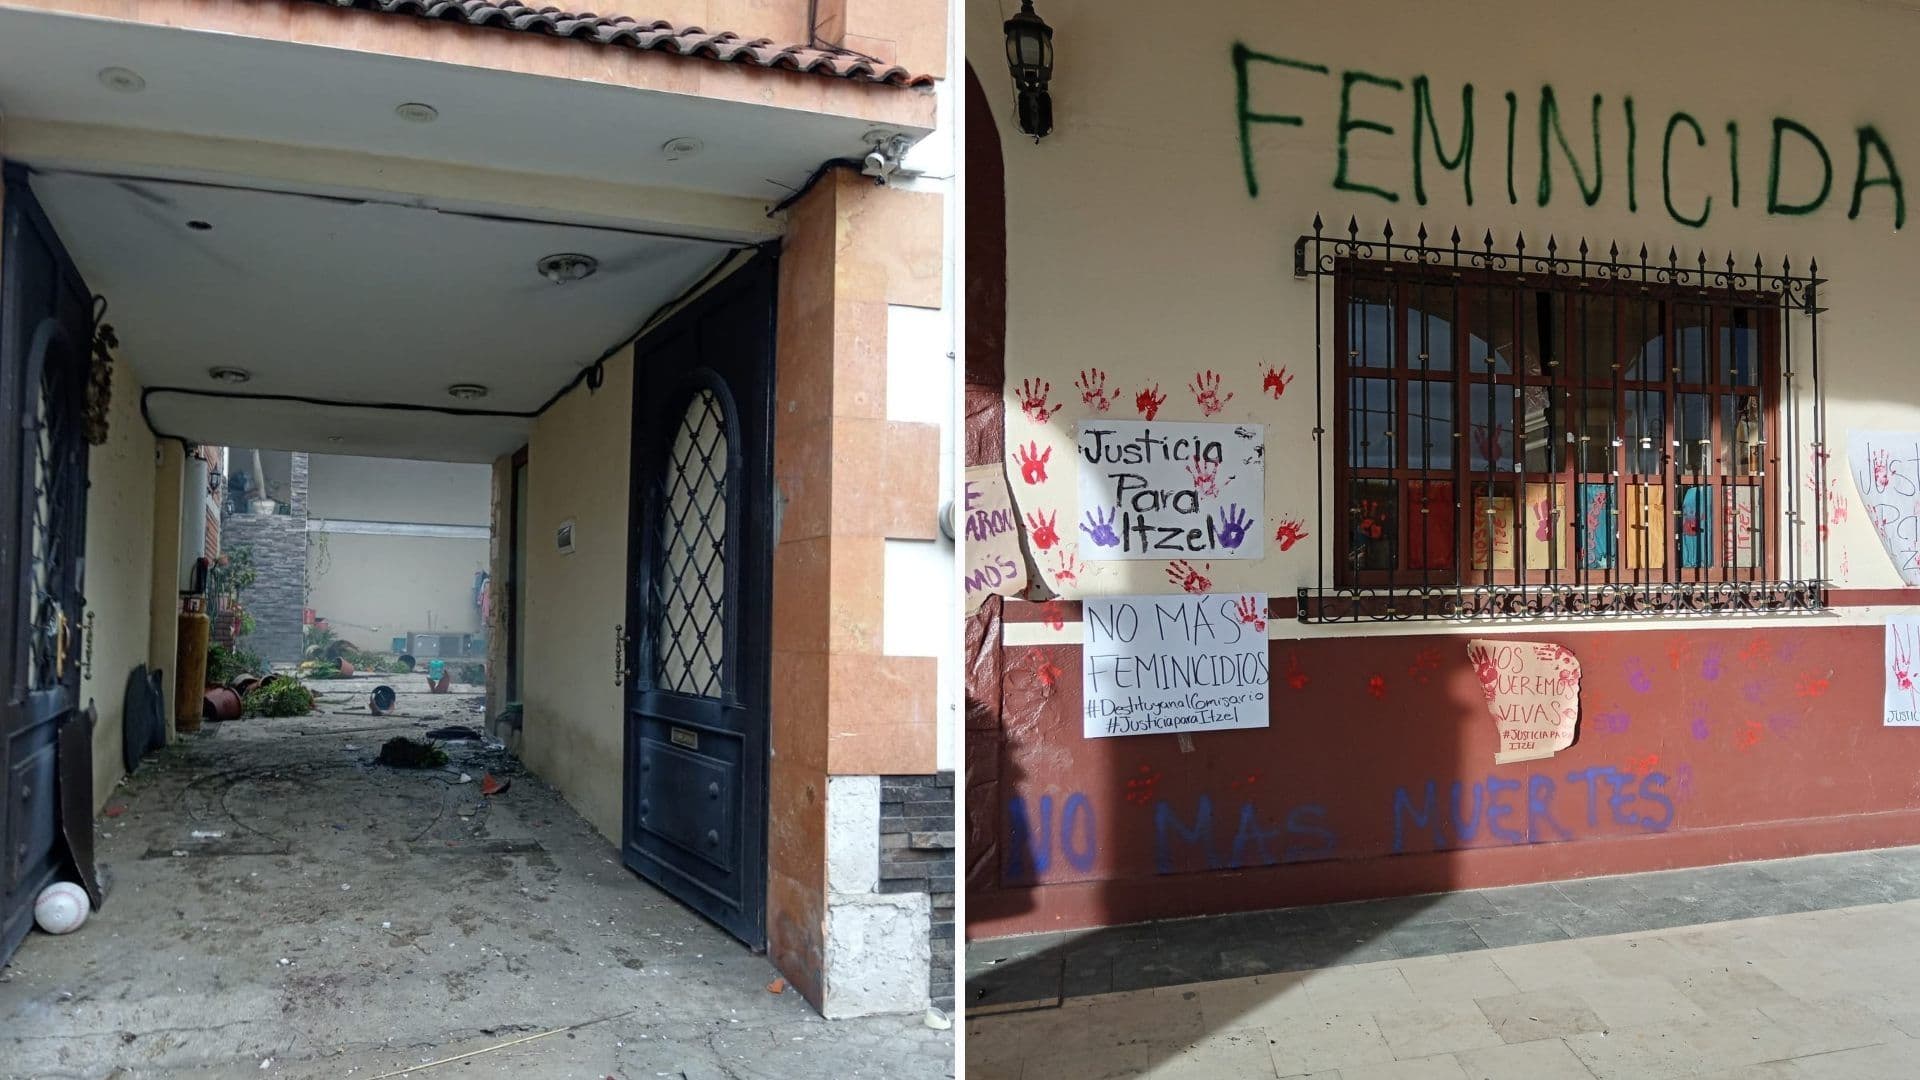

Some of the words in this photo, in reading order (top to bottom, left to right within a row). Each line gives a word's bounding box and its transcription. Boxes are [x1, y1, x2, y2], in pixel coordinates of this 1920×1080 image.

[1230, 40, 1906, 230] FEMINICIDA
[1084, 428, 1223, 464] Justicia
[1108, 473, 1200, 514] Para
[1122, 511, 1216, 553] Itzel
[1088, 603, 1138, 643] NO
[1155, 595, 1241, 645] MÁS
[1498, 700, 1561, 726] VIVAS
[1005, 792, 1097, 880] NO
[1154, 794, 1337, 878] MAS
[1392, 766, 1676, 853] MUERTES
